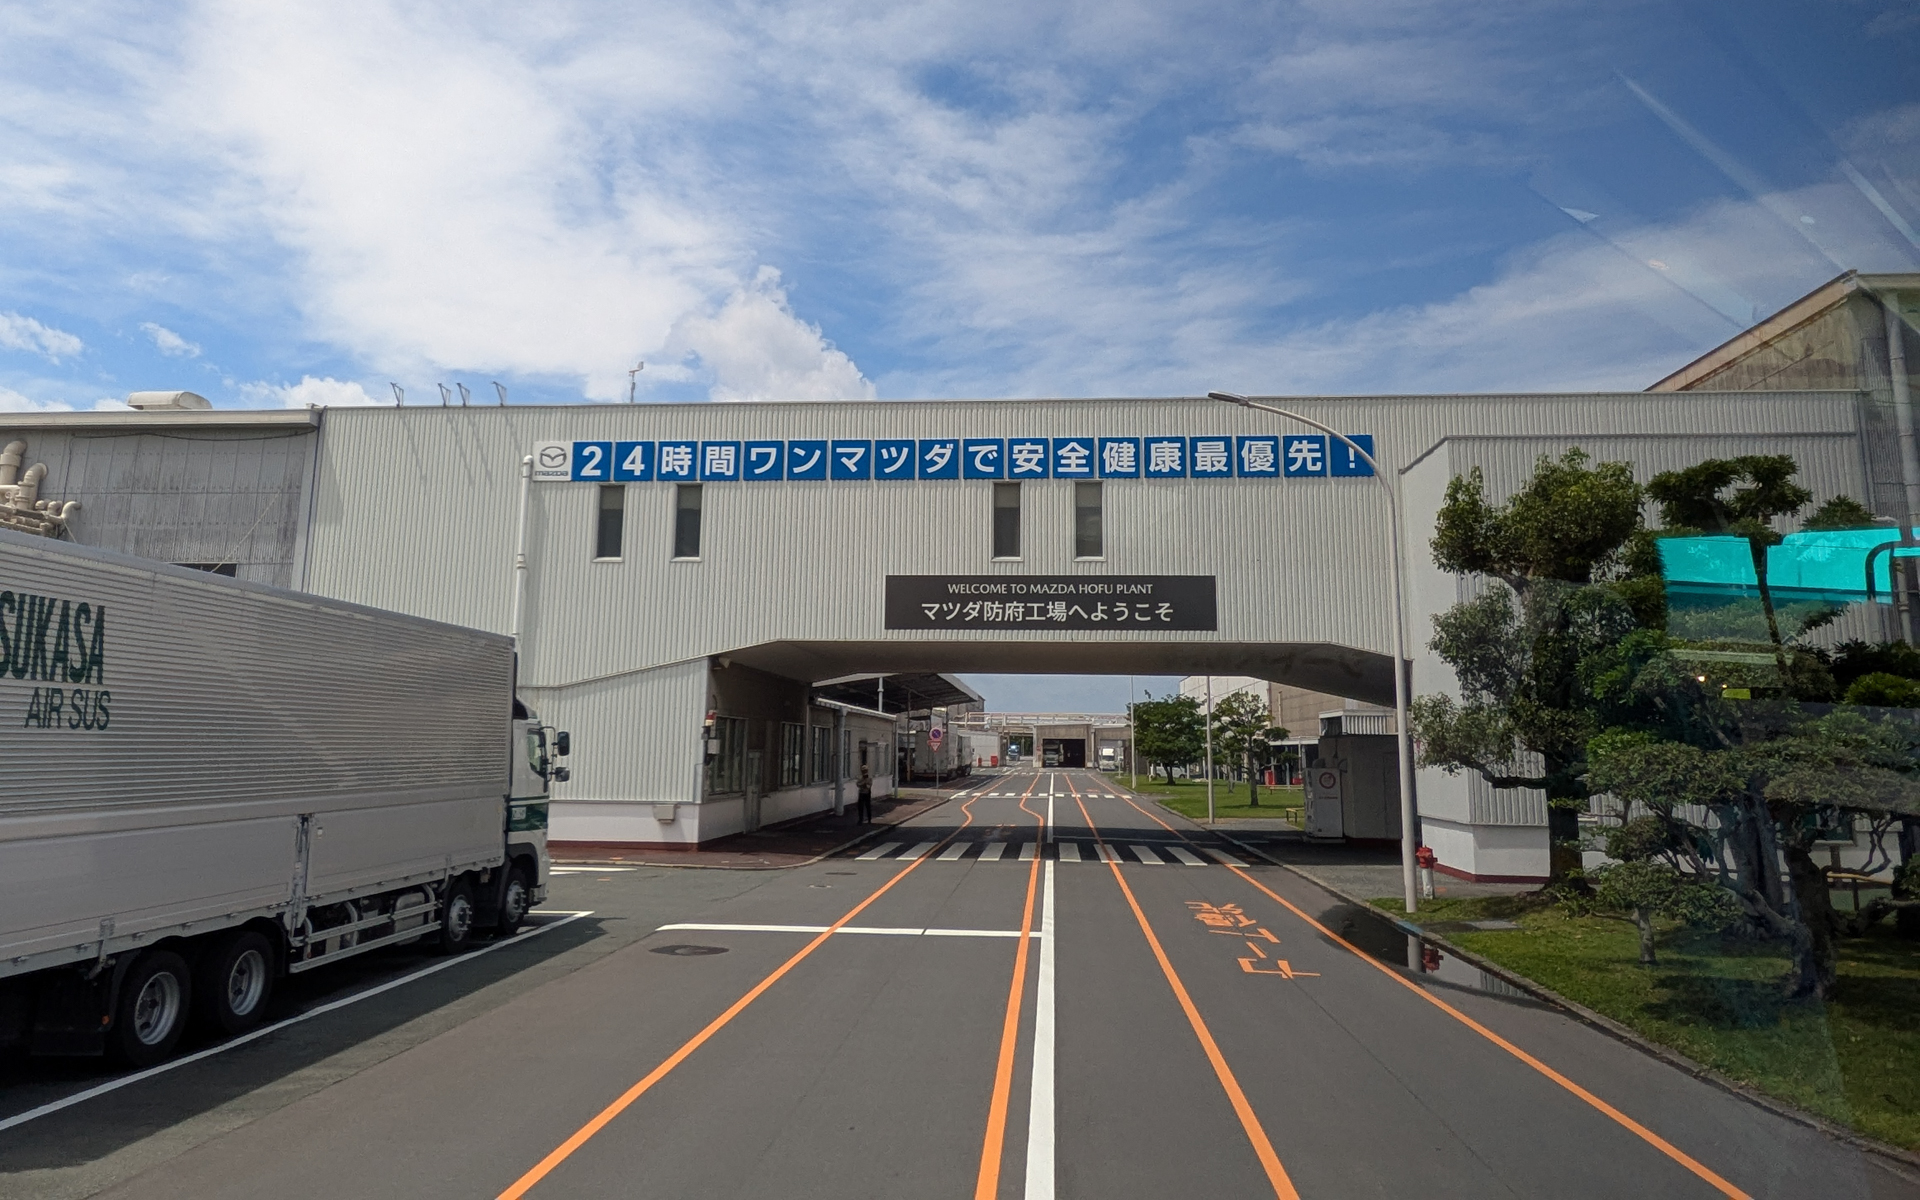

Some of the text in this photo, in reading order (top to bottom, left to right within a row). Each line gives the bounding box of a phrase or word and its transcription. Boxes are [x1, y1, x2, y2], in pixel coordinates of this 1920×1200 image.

[947, 583, 1153, 595] WELCOME TO MAZDA HOFU PLANT
[921, 600, 1174, 622] マツダ防府工場へようこそ
[24, 687, 111, 731] AIR SUS
